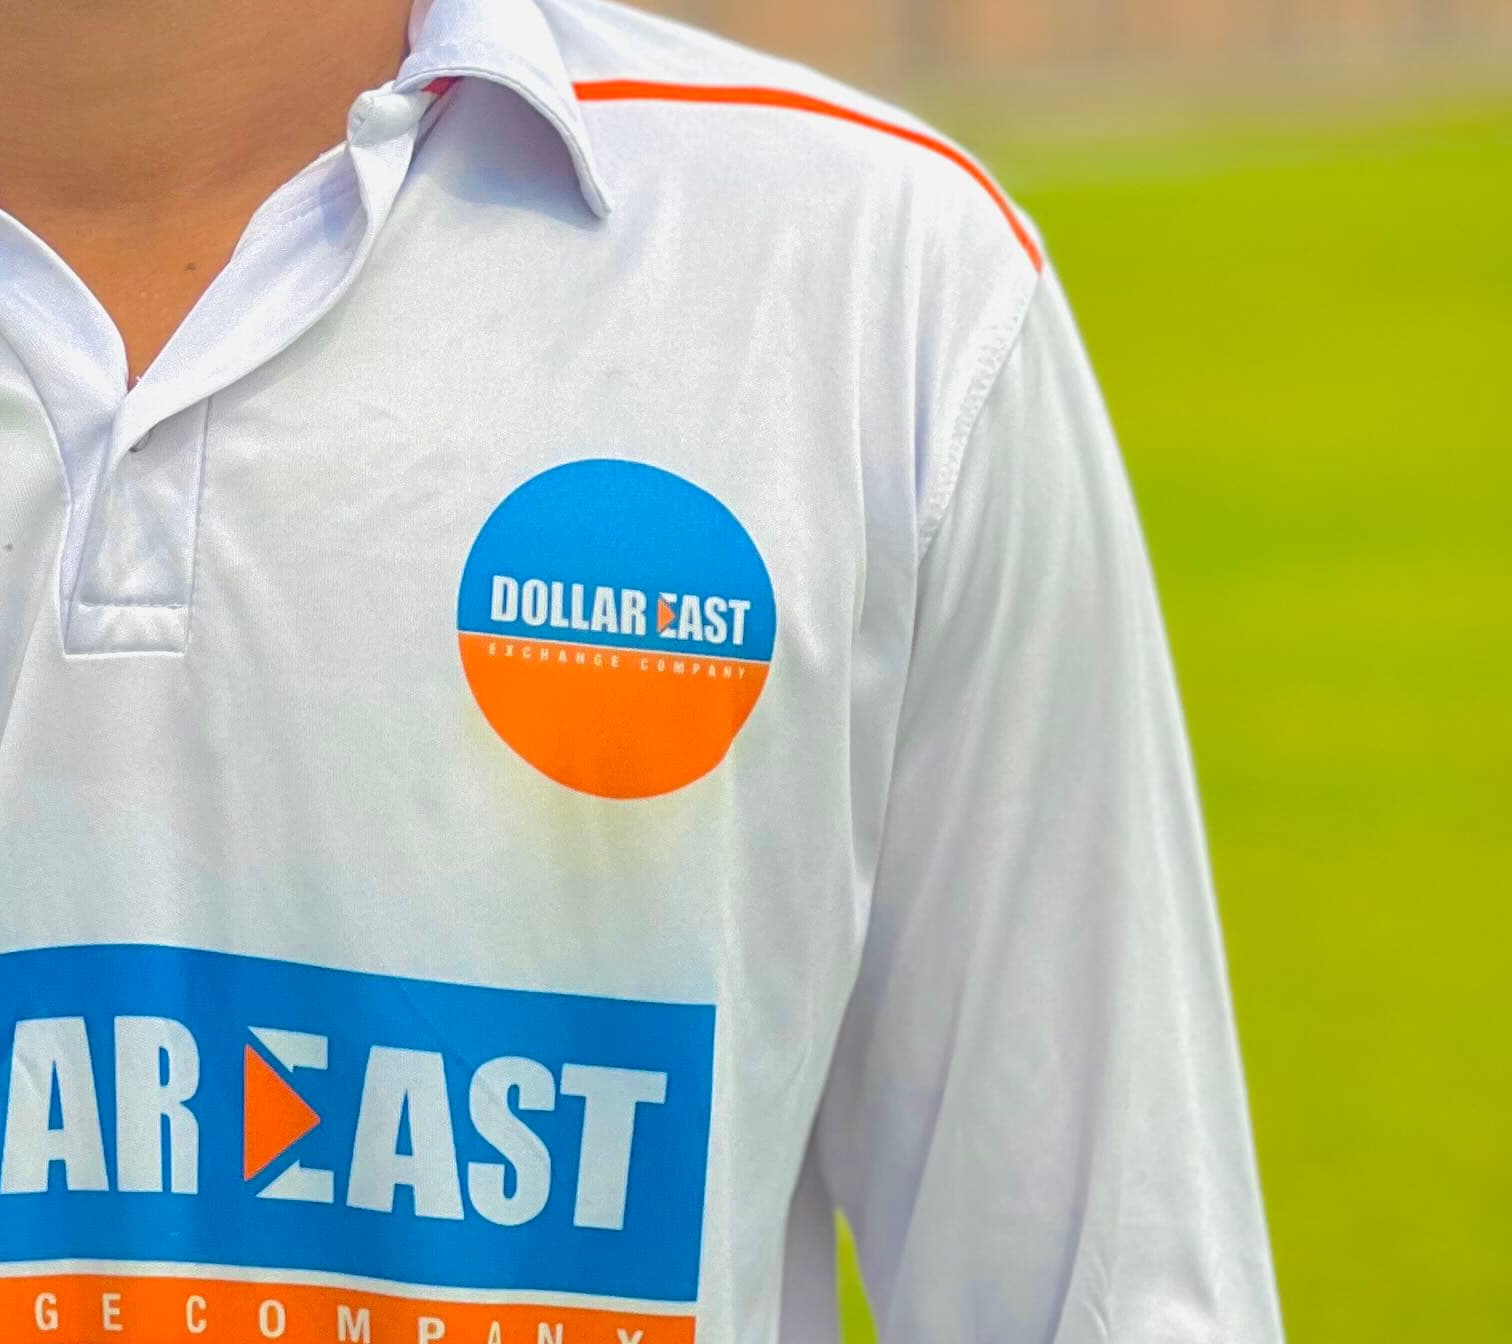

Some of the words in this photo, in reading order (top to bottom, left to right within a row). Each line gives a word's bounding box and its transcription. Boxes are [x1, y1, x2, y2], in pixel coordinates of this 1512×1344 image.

[490, 575, 648, 636] DOLLAR
[657, 592, 751, 646] EAST
[488, 642, 620, 668] EXCHANGE
[640, 658, 746, 680] COMPANY
[244, 1026, 669, 1231] EAST
